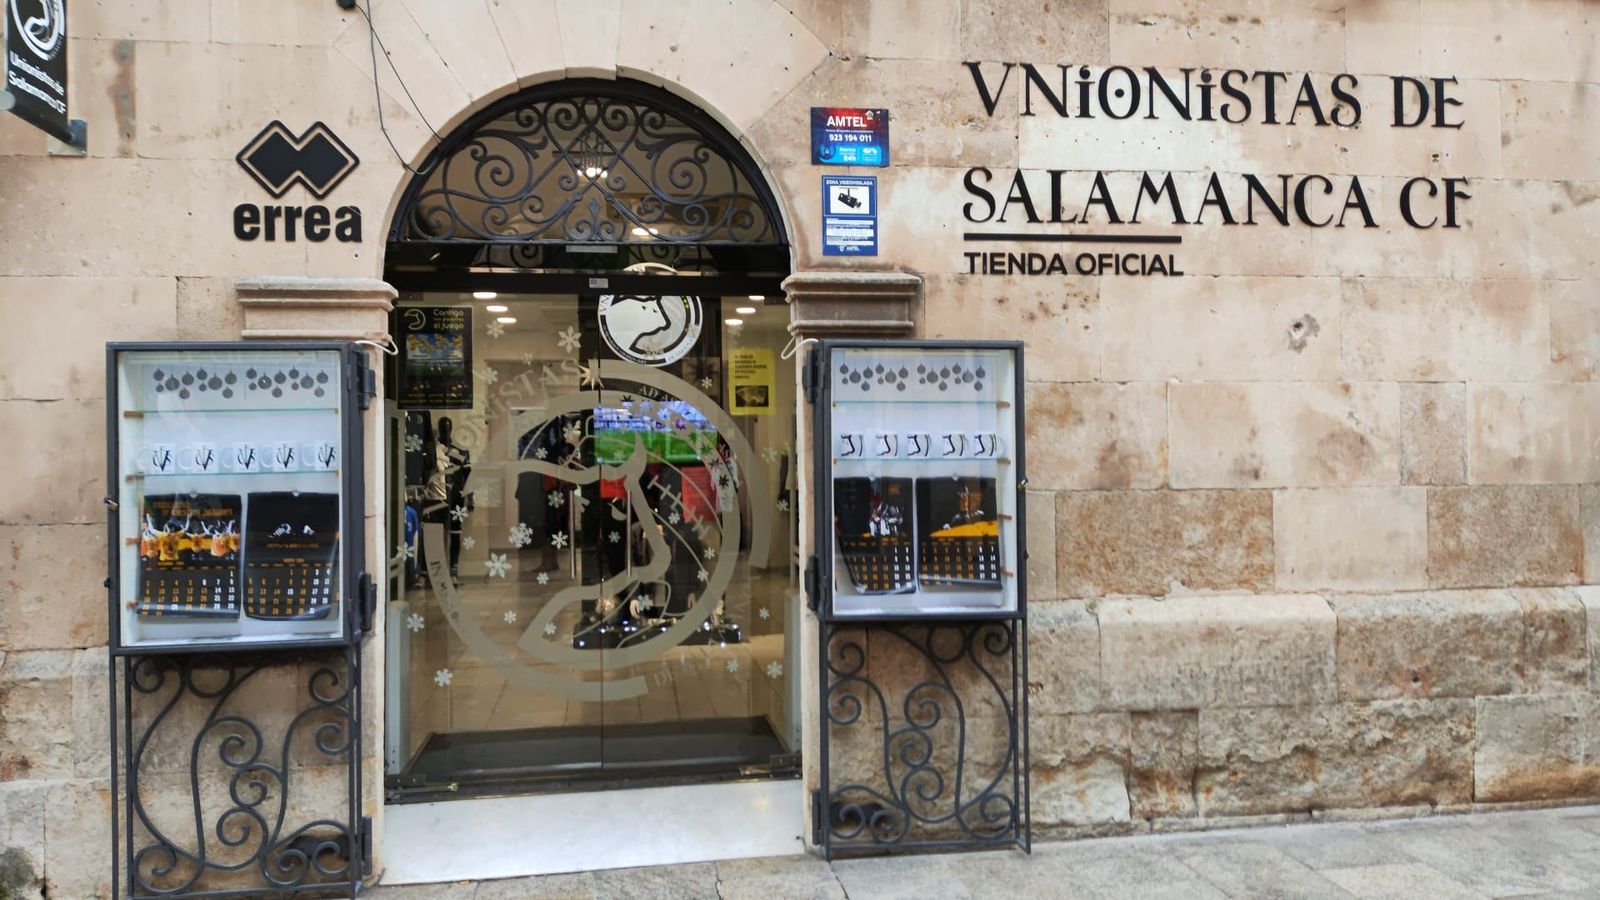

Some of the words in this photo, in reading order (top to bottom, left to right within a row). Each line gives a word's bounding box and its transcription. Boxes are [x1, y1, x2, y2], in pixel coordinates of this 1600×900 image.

[1390, 75, 1466, 130] DE
[826, 116, 867, 128] AMTEL
[828, 134, 843, 142] 923
[844, 134, 858, 142] 194
[962, 166, 1380, 229] SALAMANCA
[1399, 175, 1473, 230] CF
[233, 203, 362, 243] errea
[964, 251, 1068, 276] TIENDA
[1074, 252, 1184, 277] OFICIAL
[433, 309, 464, 318] Contigo
